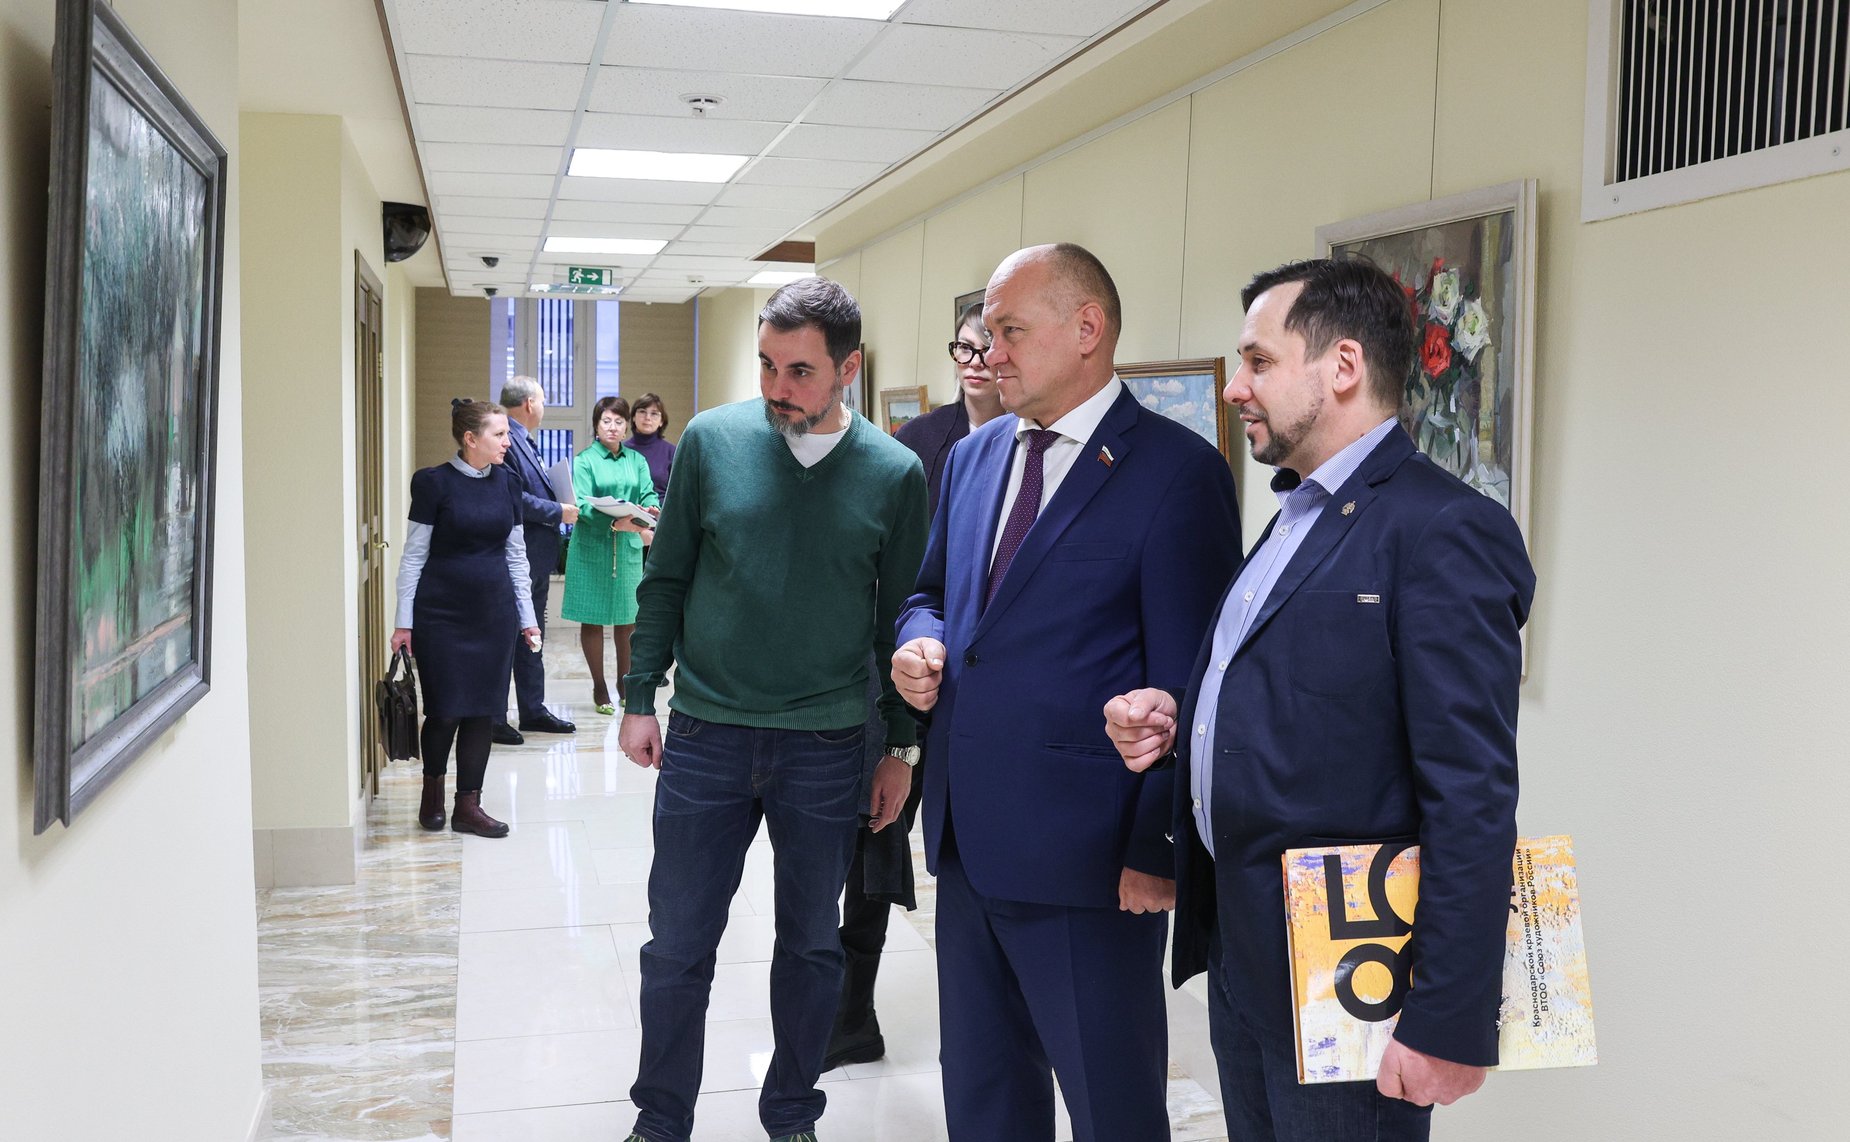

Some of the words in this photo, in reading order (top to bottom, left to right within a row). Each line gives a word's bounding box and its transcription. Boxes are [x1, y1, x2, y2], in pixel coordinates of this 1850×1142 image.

[1516, 848, 1529, 909] организации
[1525, 848, 1535, 887] России»
[1521, 911, 1534, 950] краевой
[1530, 890, 1543, 947] художников
[1537, 948, 1545, 980] «Союз
[1526, 952, 1541, 1028] Краснодарской
[1539, 982, 1549, 1012] ВТОО
